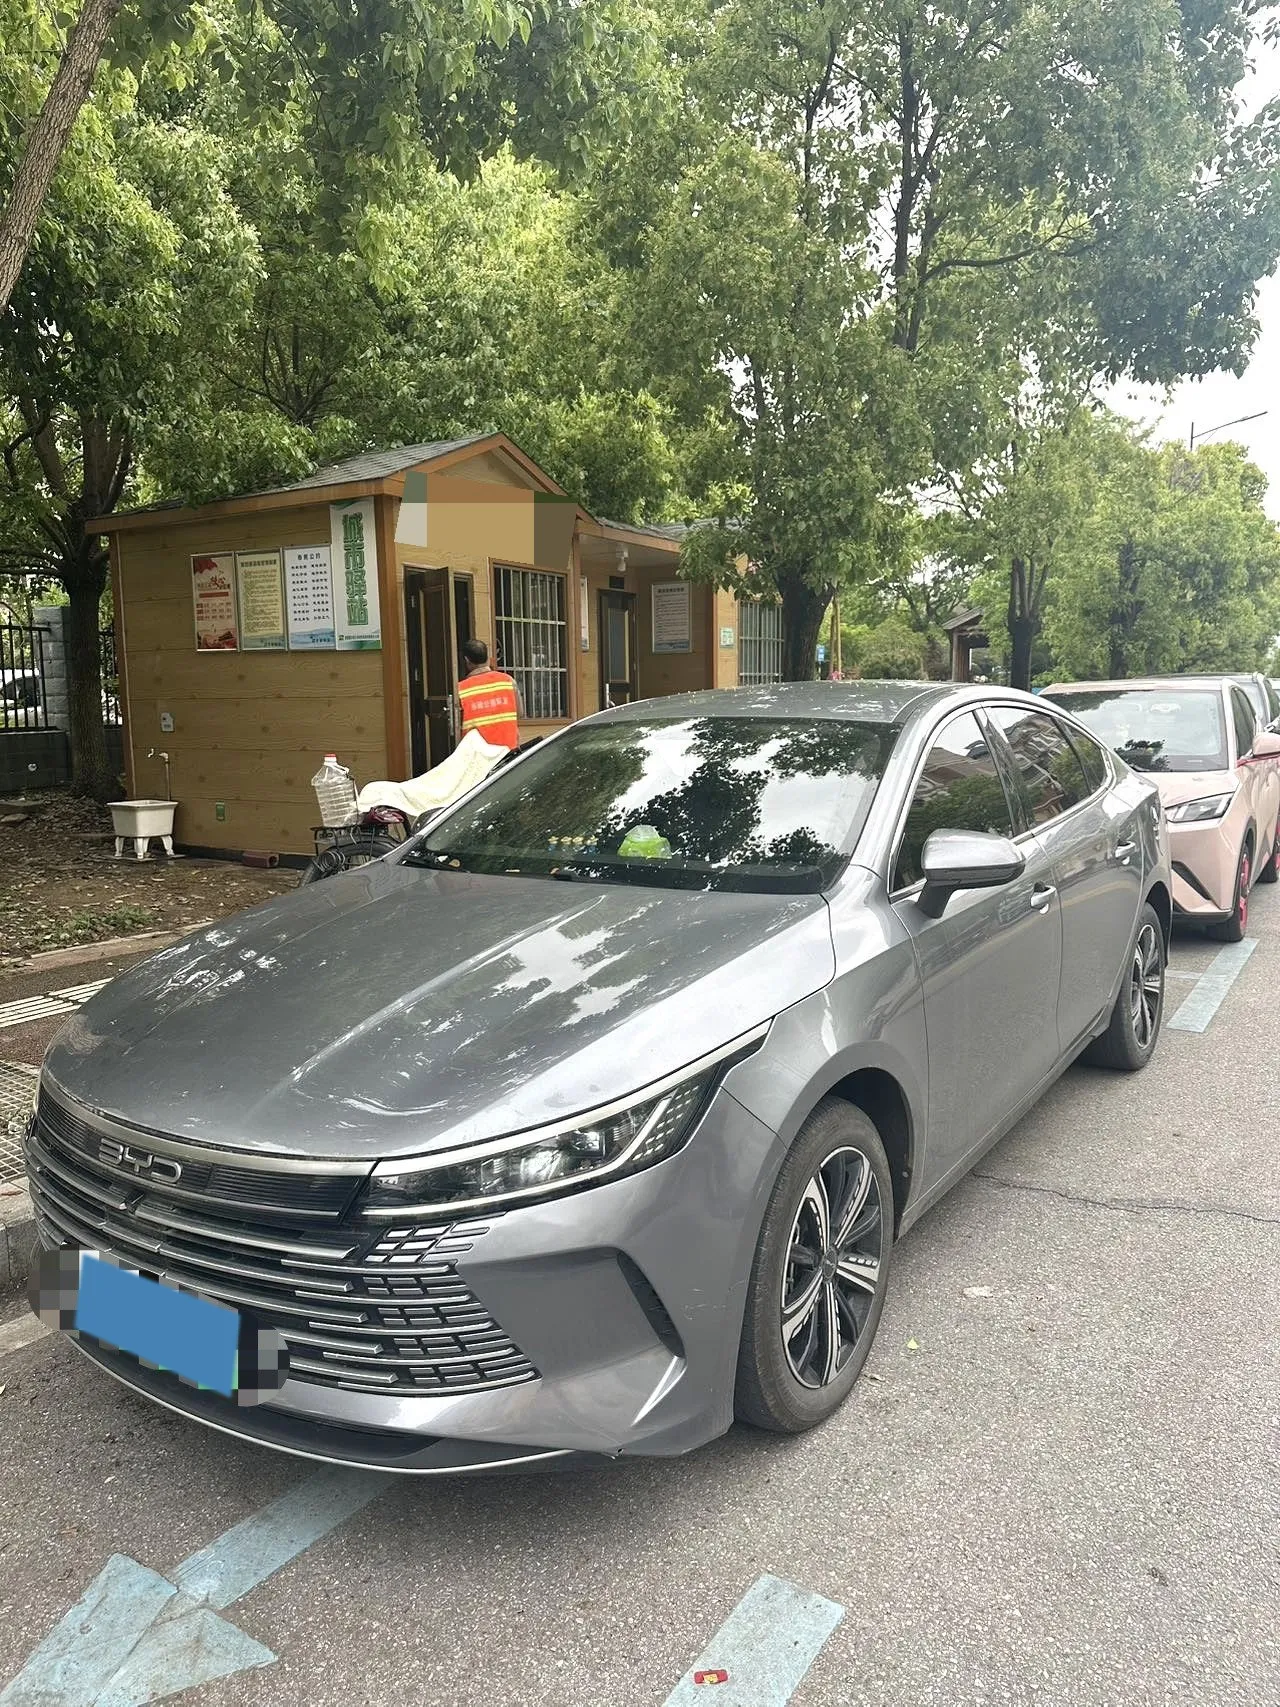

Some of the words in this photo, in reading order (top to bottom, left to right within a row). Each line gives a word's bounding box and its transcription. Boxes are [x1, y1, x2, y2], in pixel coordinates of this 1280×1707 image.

[342, 511, 369, 626] 城市驿站
[98, 1138, 182, 1184] BYD
